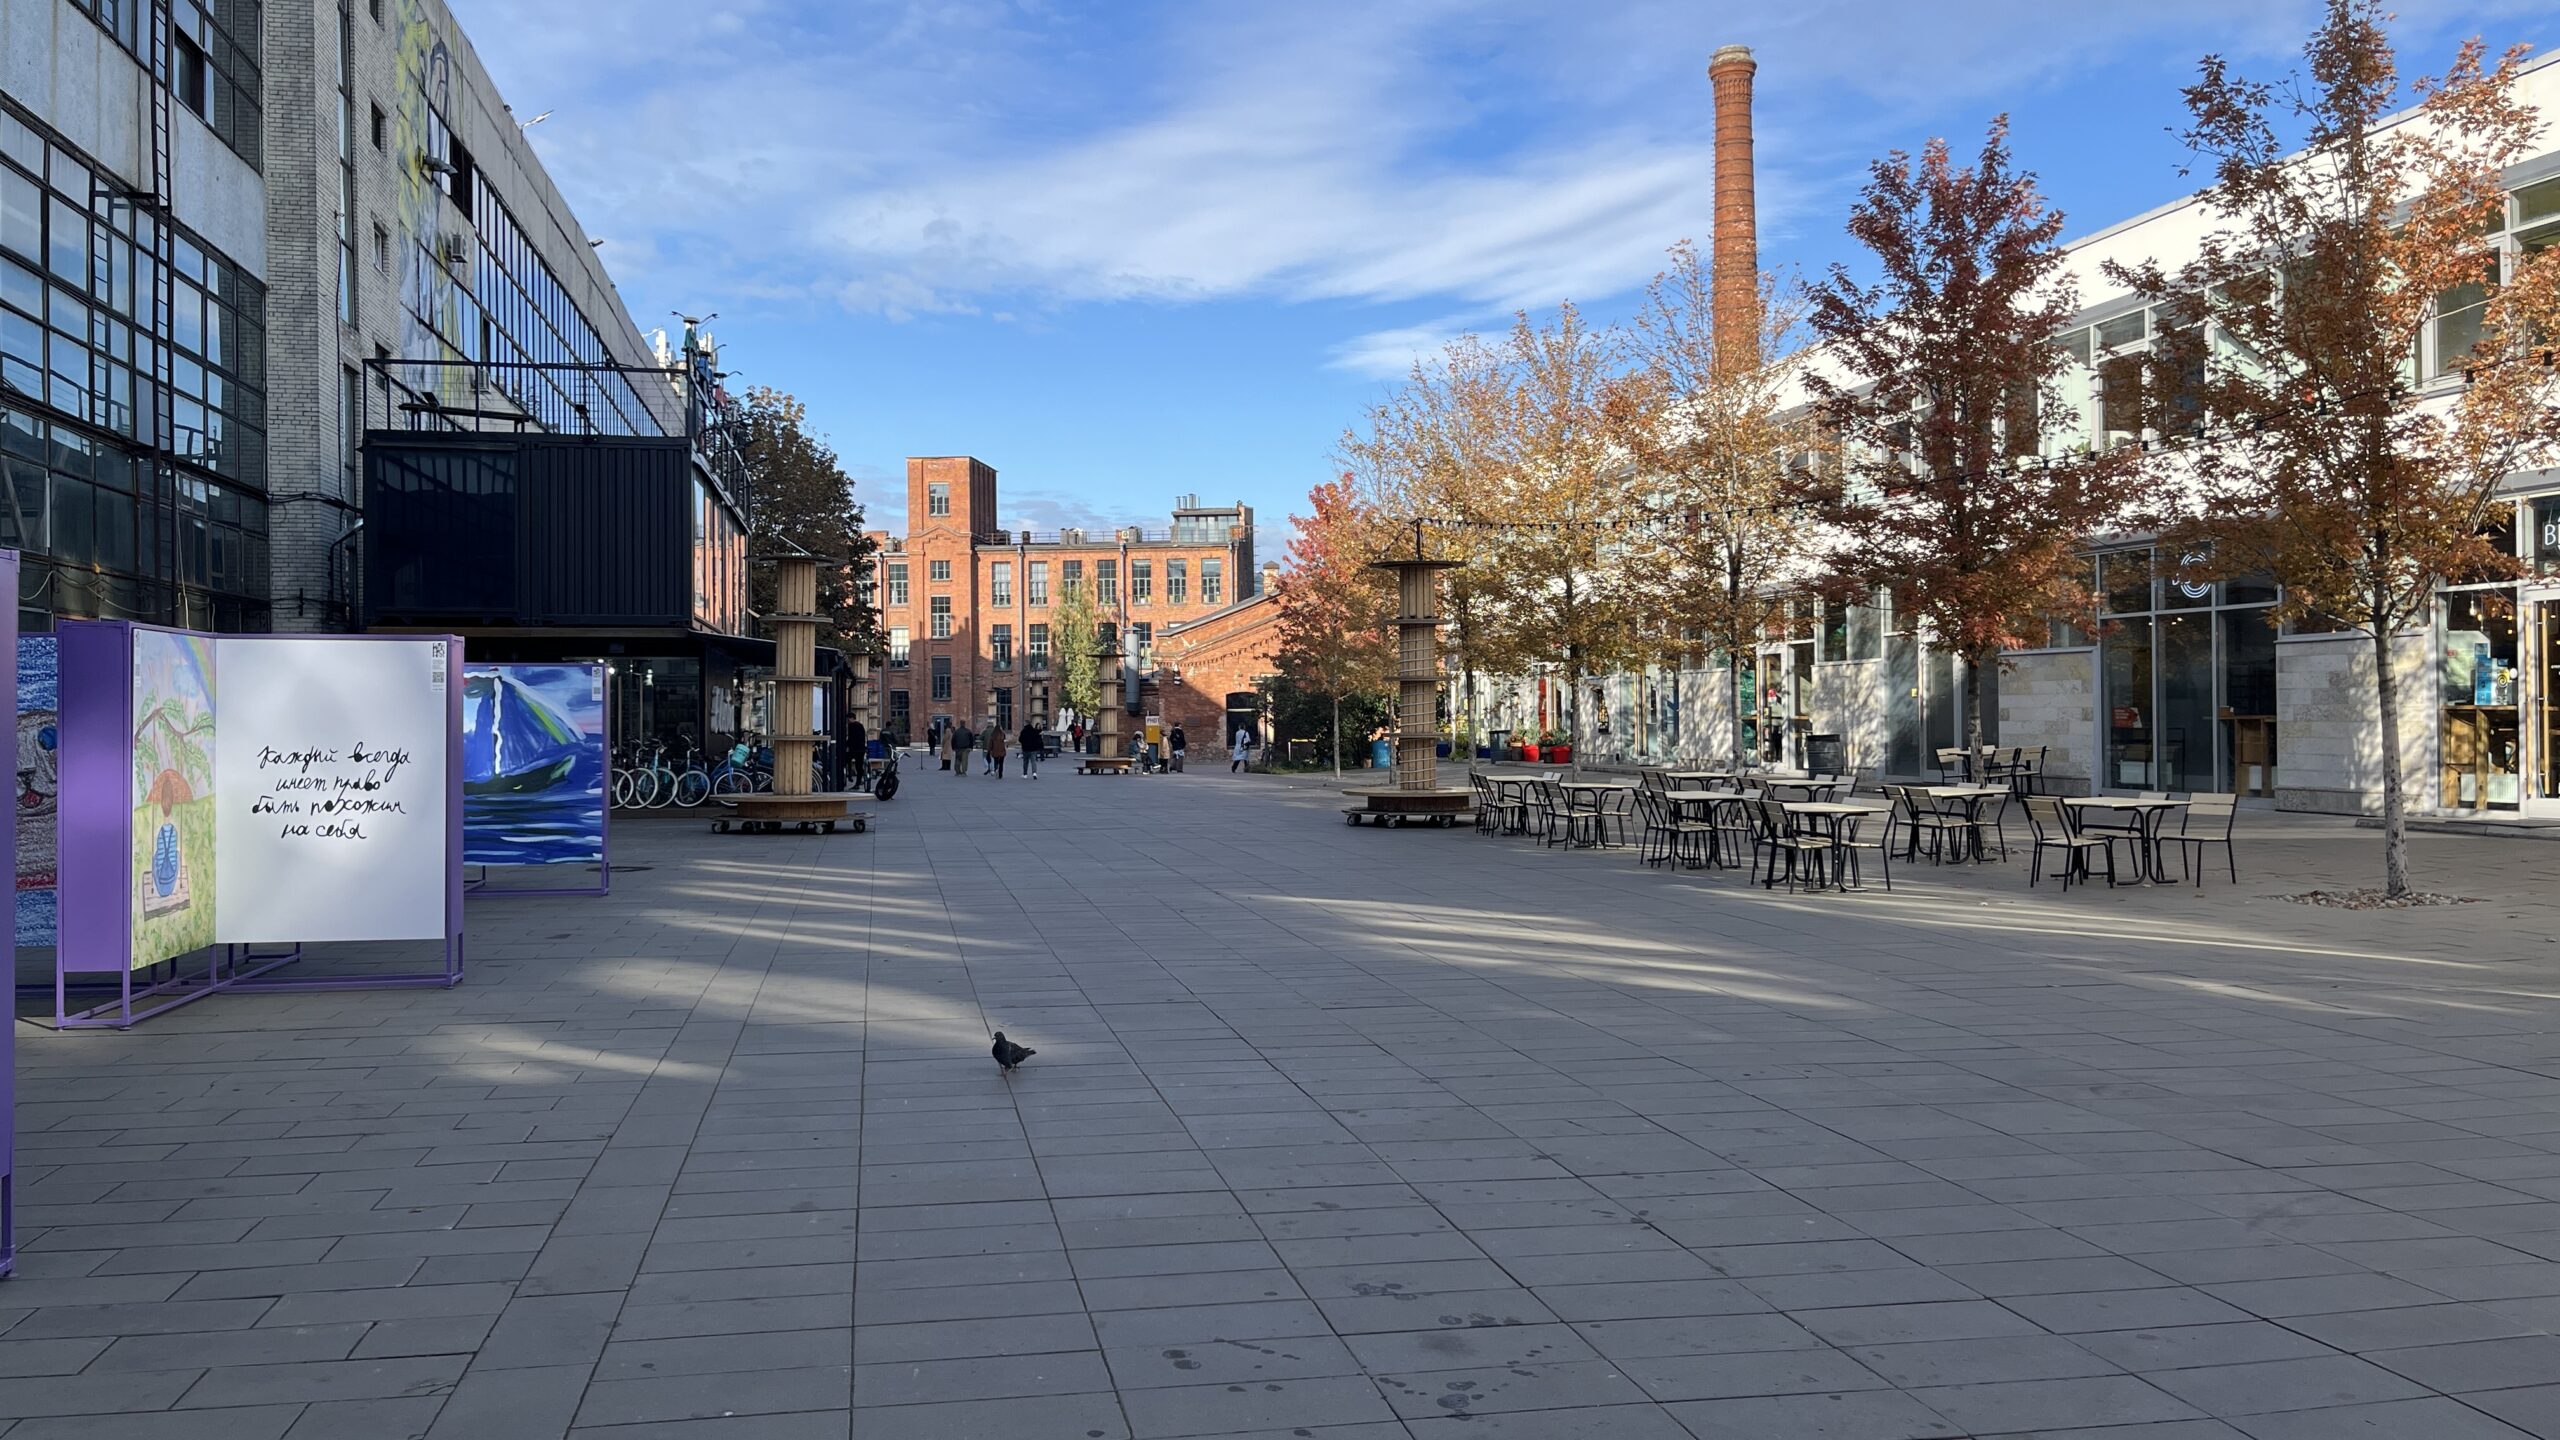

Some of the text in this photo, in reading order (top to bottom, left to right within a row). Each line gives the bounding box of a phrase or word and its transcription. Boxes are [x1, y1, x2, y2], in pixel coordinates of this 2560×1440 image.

[2545, 523, 2560, 546] B
[257, 741, 411, 782] Каждый всегда
[275, 769, 381, 799] имеет право
[252, 795, 407, 816] быть похожим
[281, 818, 367, 839] на себя
